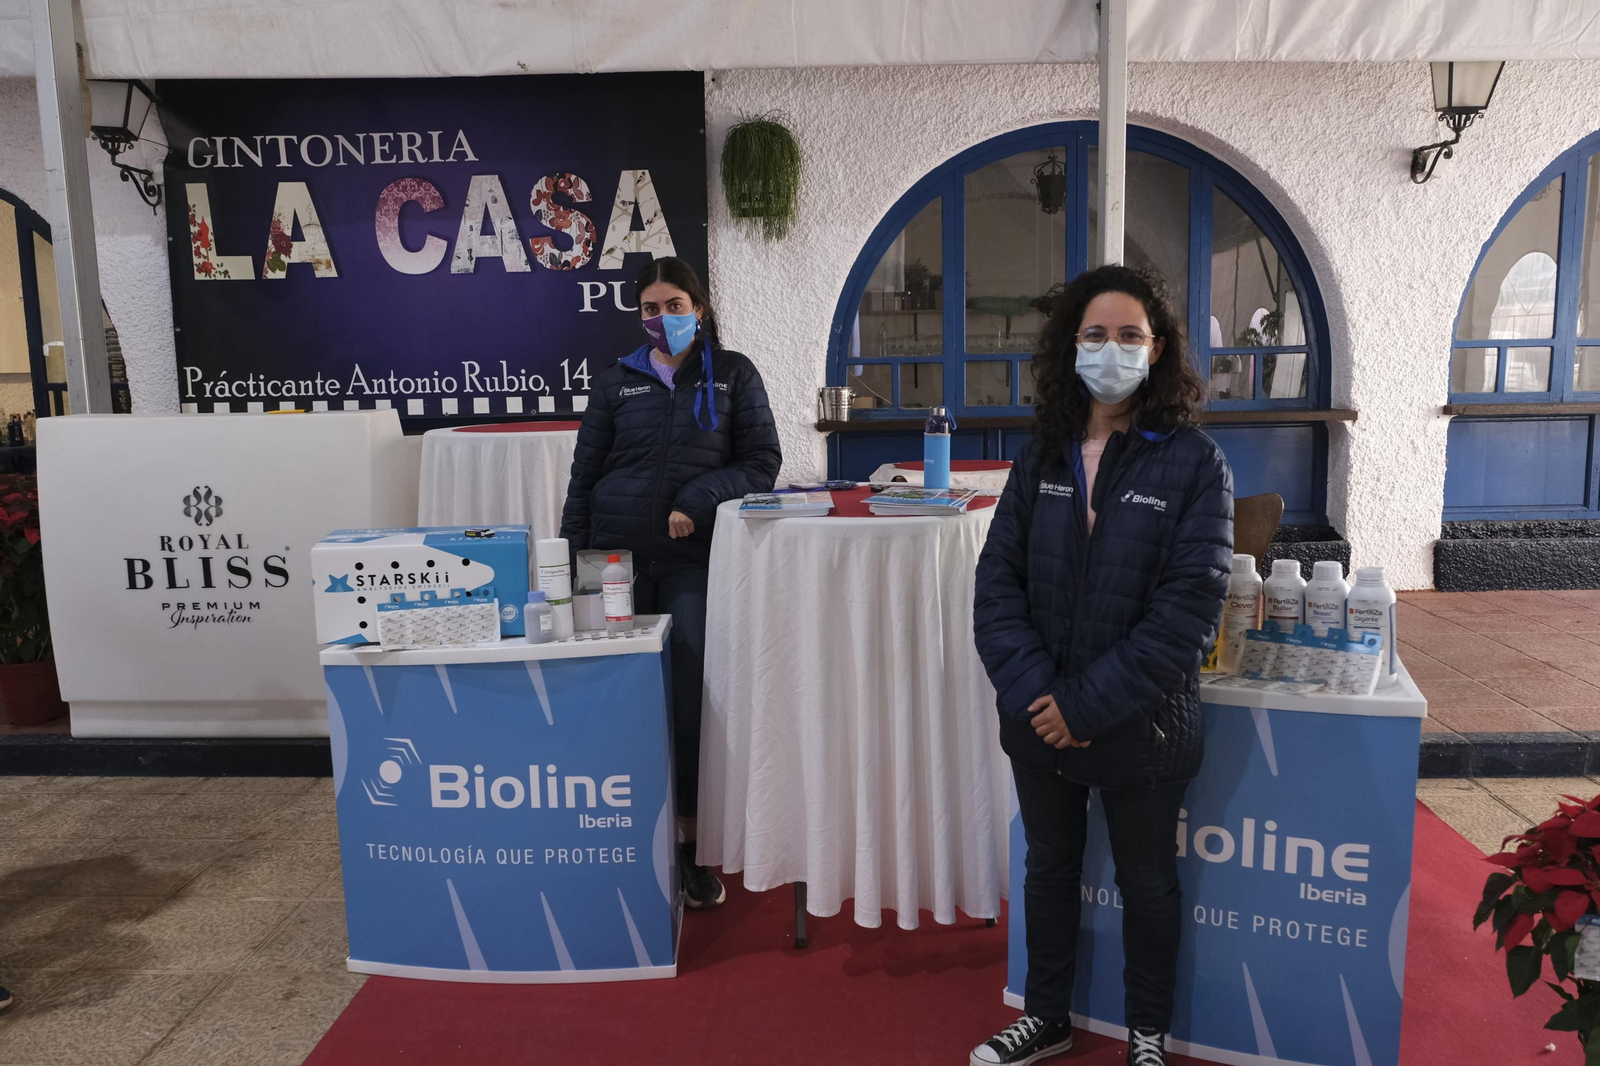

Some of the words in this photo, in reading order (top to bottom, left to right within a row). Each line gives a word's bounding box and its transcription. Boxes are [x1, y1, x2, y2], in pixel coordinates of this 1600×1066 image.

[187, 129, 479, 168] GINTONERIA
[185, 181, 339, 280] LA
[375, 169, 677, 275] CASA
[577, 281, 639, 312] PU
[183, 365, 340, 398] Prácticante
[347, 363, 458, 396] Antonio
[462, 359, 550, 396] Rubio,
[560, 357, 592, 391] 14
[1054, 483, 1074, 493] Heron
[1132, 494, 1168, 508] Bioline
[159, 533, 249, 552] ROYAL
[162, 602, 260, 610] PREMIUM
[167, 609, 254, 630] Inspiration
[429, 764, 632, 809] Bioline
[579, 813, 632, 829] Iberia
[366, 843, 486, 865] TECNOLOGÍA
[496, 849, 534, 865] QUE
[545, 847, 637, 865] PROTEGE
[1175, 808, 1370, 882] ioline
[1300, 883, 1367, 906] Iberia
[1194, 905, 1239, 930] QUE
[1253, 915, 1368, 948] PROTEGE
